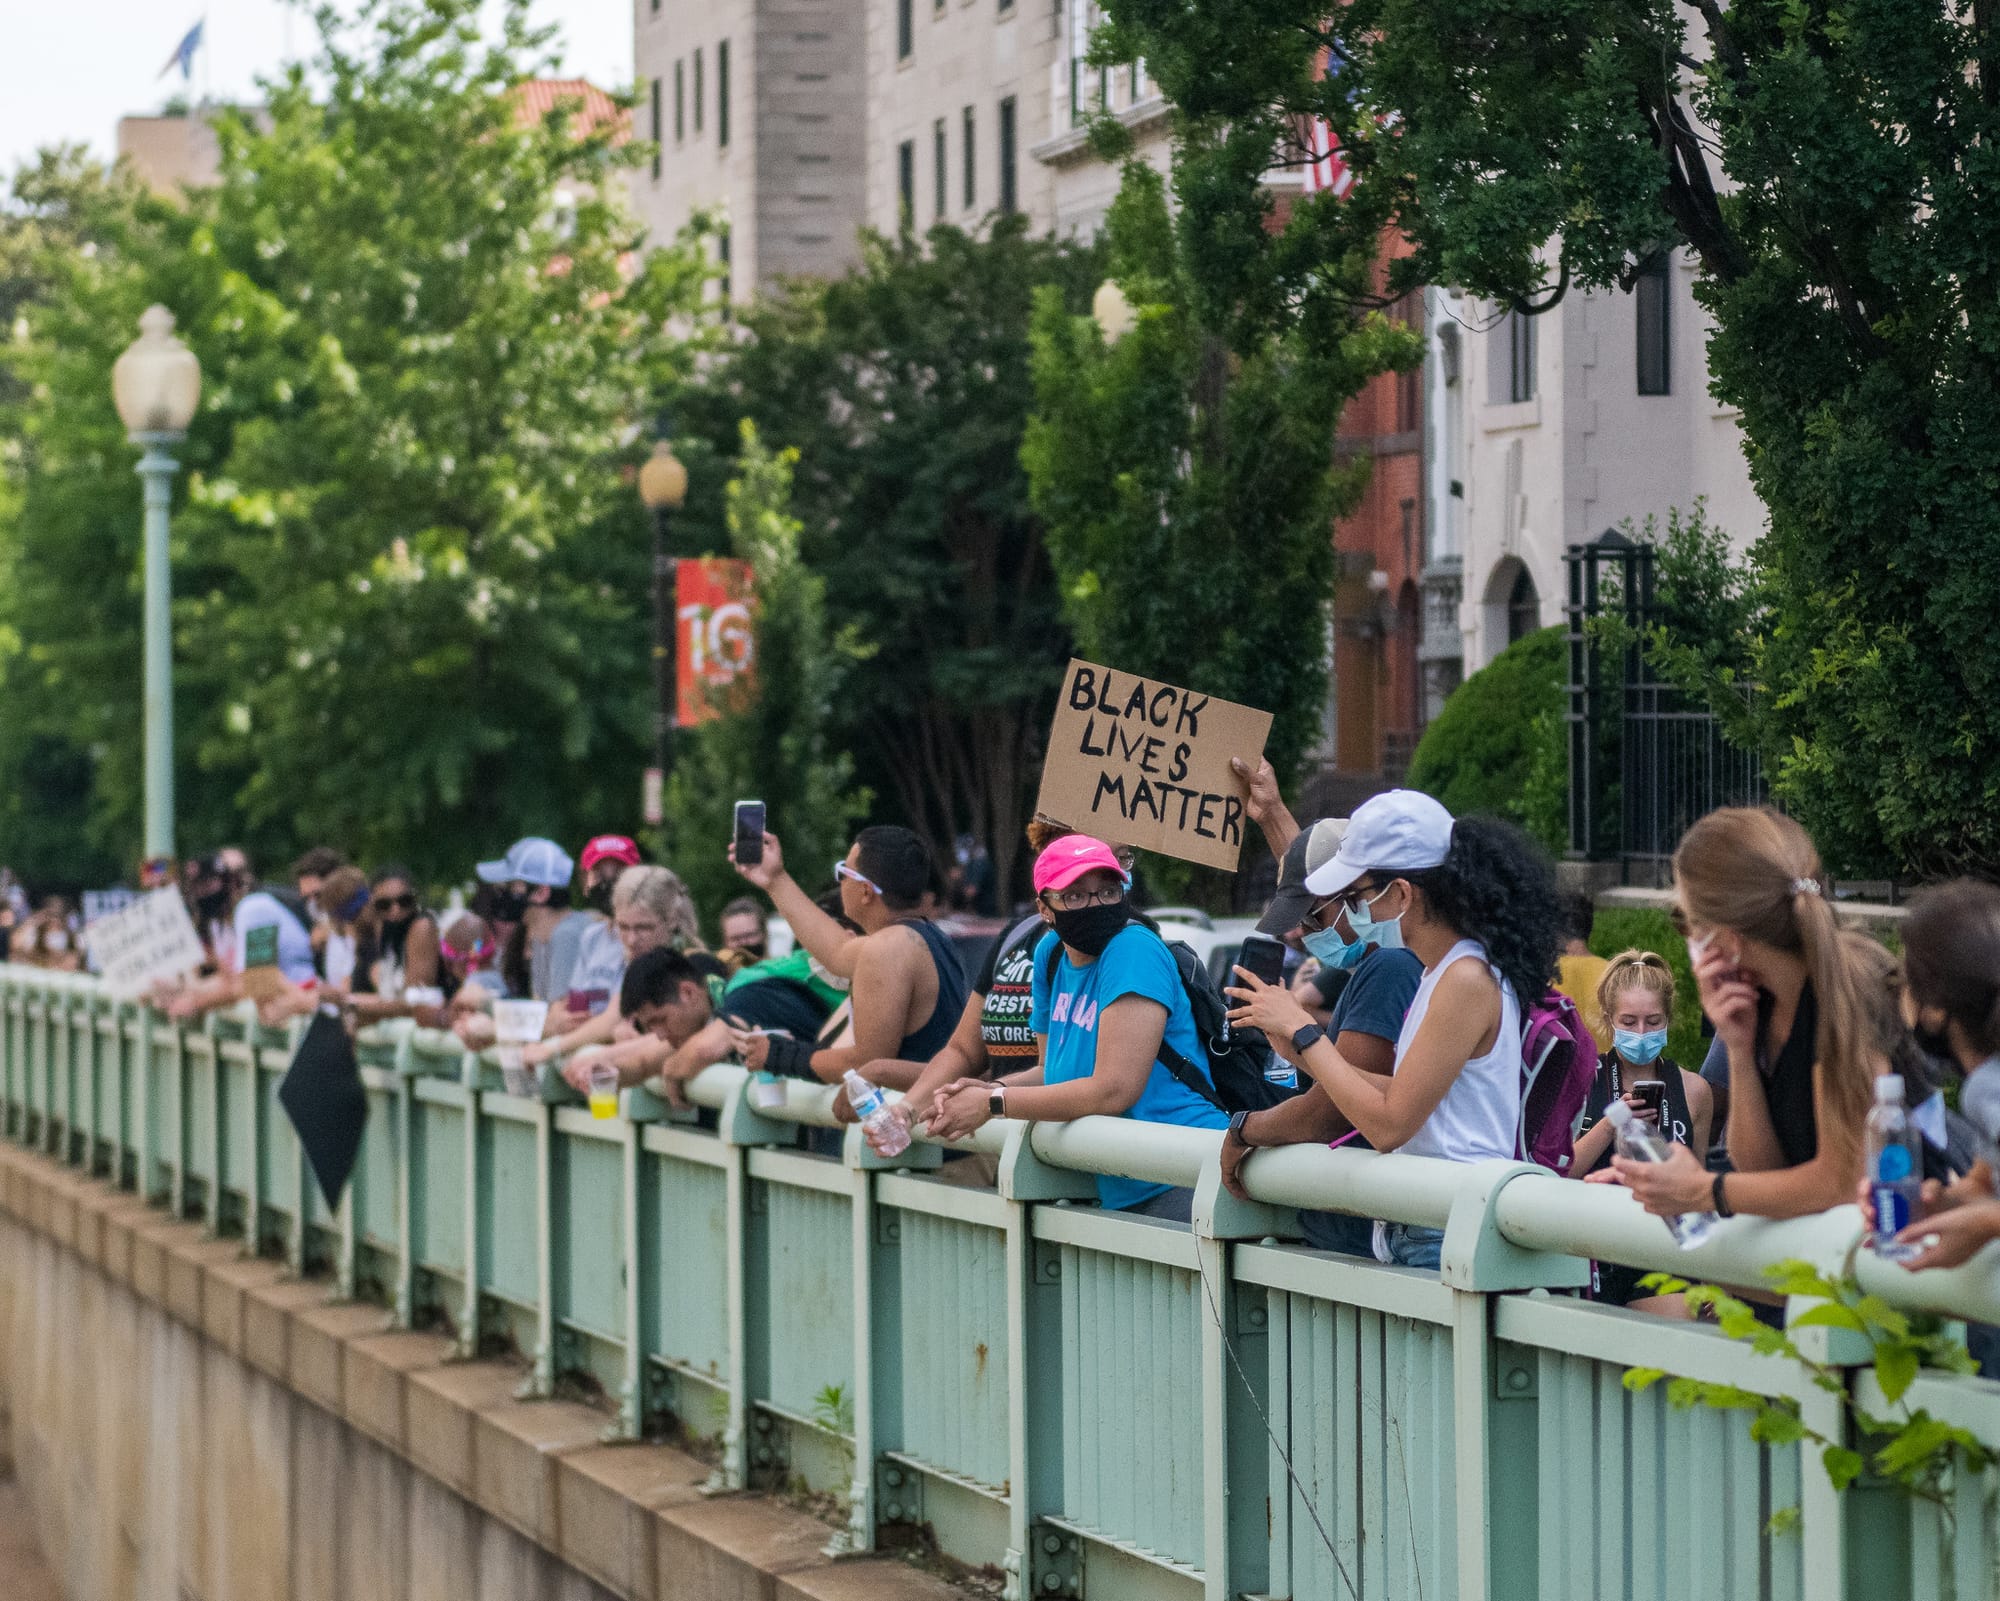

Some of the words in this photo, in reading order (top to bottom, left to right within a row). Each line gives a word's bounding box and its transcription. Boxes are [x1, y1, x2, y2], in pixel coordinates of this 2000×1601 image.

[678, 603, 752, 672] 16
[1070, 667, 1208, 737] BLACK
[1080, 714, 1191, 781] LIVES
[1092, 771, 1242, 846] MATTER
